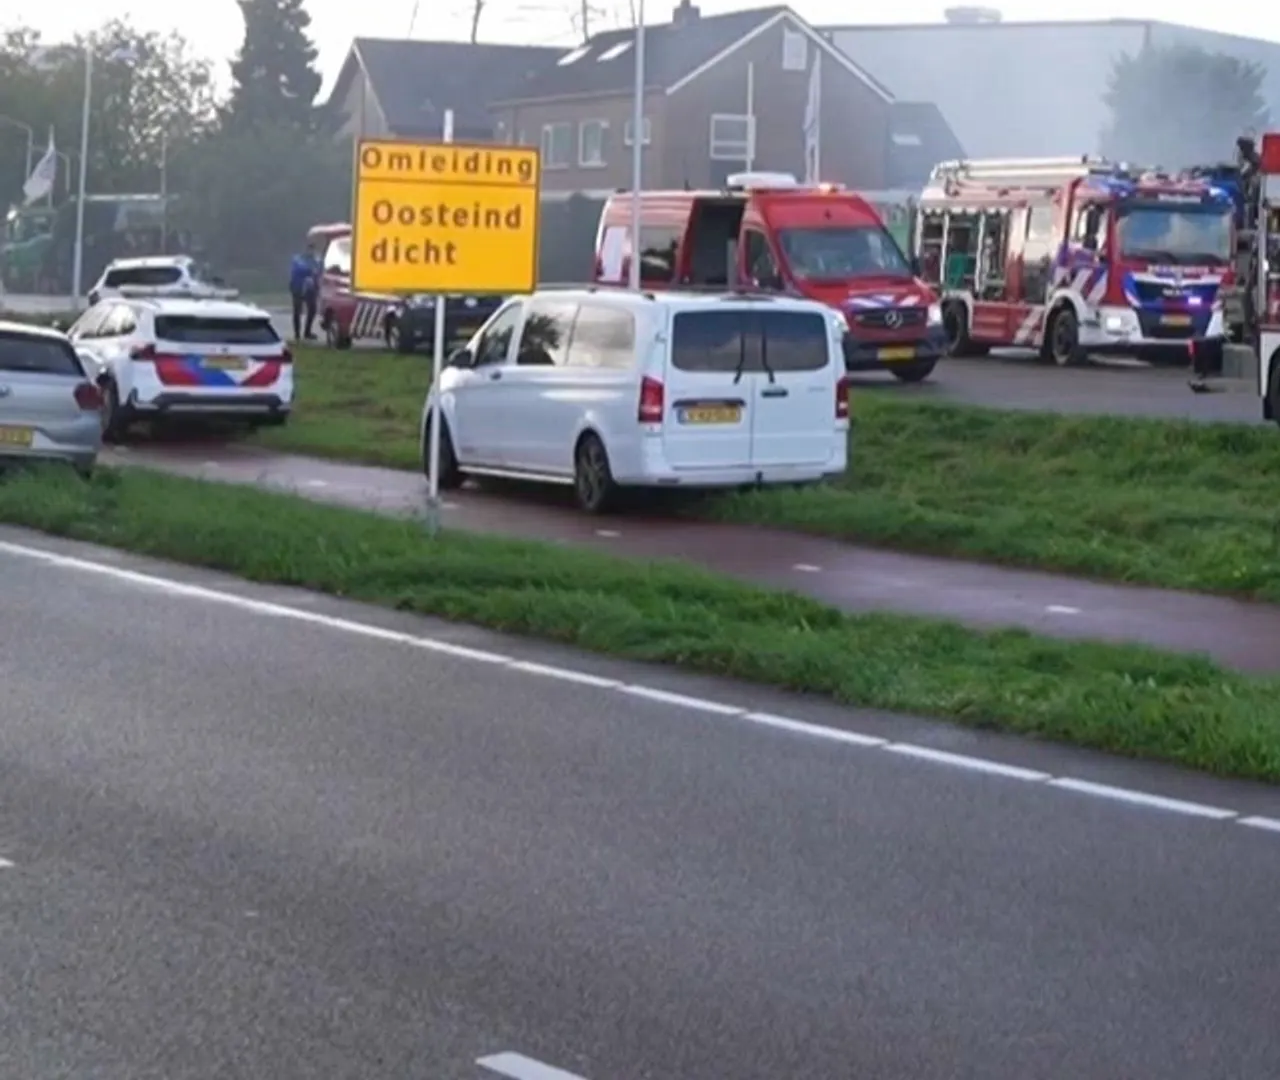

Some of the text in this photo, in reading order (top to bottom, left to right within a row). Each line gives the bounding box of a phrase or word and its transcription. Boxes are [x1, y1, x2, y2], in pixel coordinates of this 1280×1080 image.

[361, 146, 533, 180] Omleiding
[372, 199, 522, 230] Oosteind
[370, 237, 458, 265] dicht
